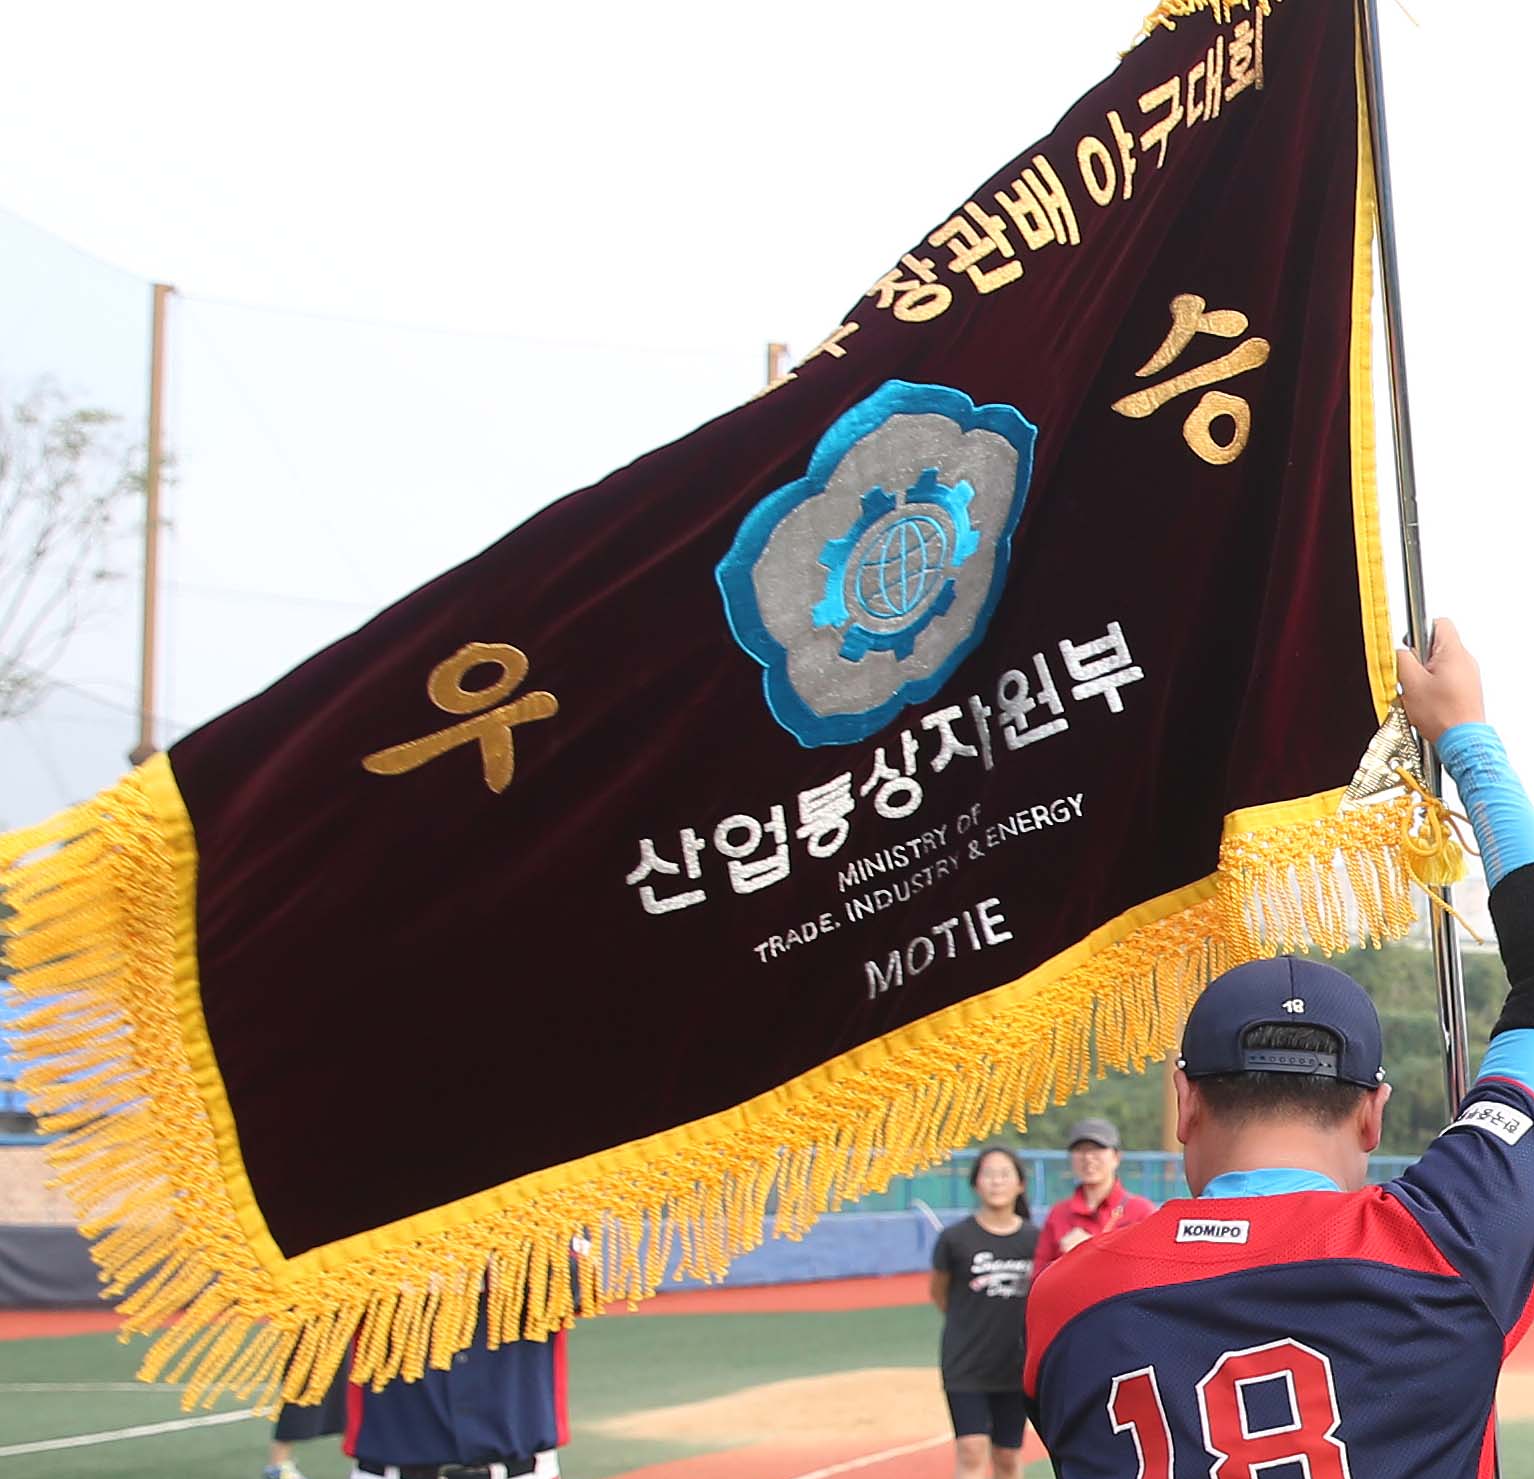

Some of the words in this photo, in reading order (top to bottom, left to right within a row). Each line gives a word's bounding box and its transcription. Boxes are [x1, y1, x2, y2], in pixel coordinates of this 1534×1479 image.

[866, 155, 1081, 322] 장관배
[1077, 7, 1264, 206] 야구대회
[362, 641, 558, 794] 우
[1111, 293, 1270, 465] 승
[625, 621, 1145, 915] 산업통상자원부
[838, 824, 948, 893] MINISTRY
[956, 802, 983, 834] OF
[844, 854, 960, 923] INDUSTRY
[967, 839, 986, 861] &
[986, 793, 1086, 849] ENERGY
[864, 897, 1014, 1000] MOTIE
[1282, 998, 1305, 1014] 18
[1182, 1224, 1242, 1239] KOMIPO
